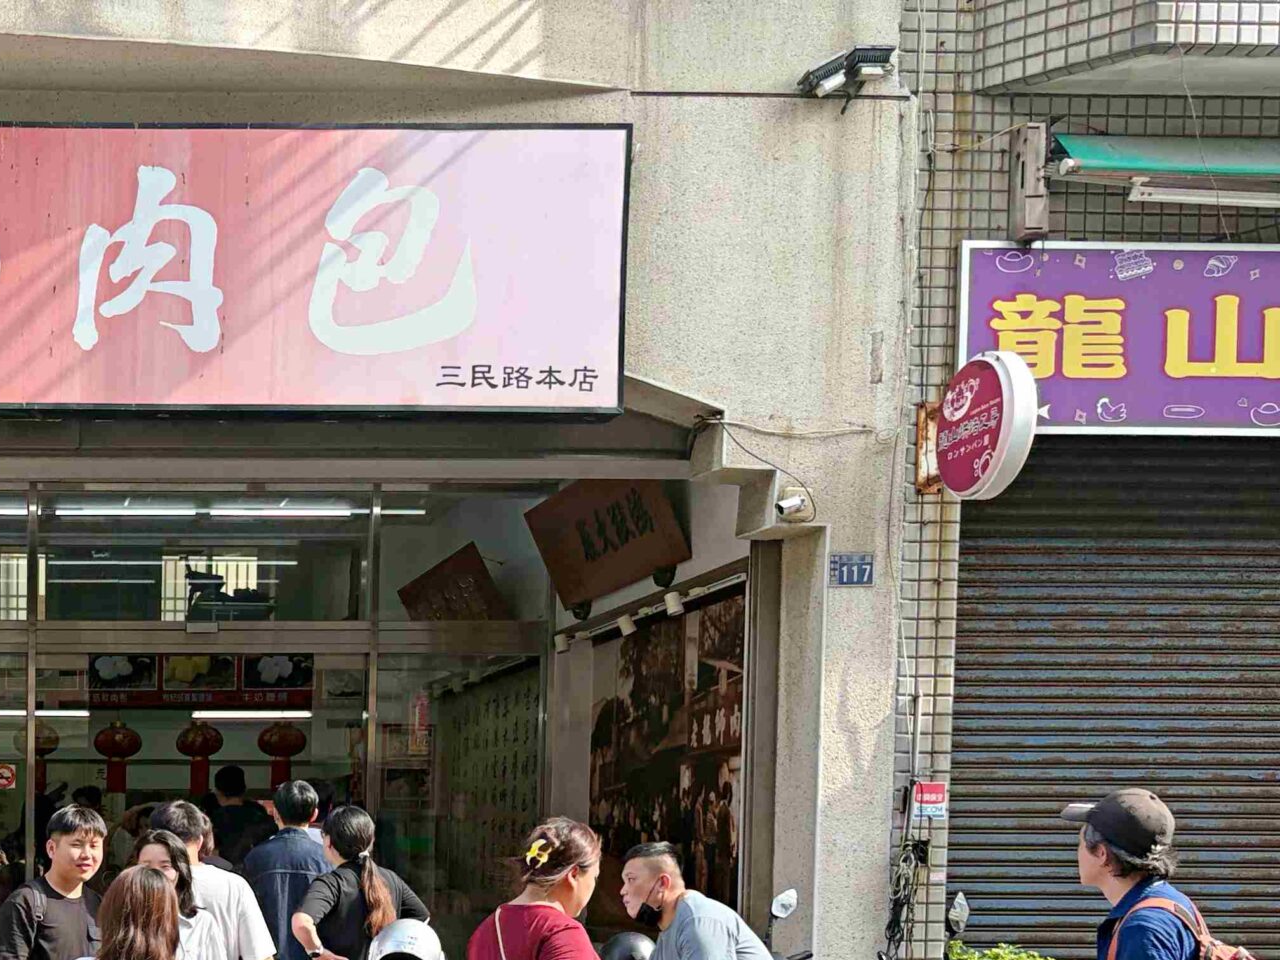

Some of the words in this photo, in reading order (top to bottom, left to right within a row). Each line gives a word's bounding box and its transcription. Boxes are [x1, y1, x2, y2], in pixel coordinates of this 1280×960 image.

[990, 294, 1280, 379] 龍山
[436, 364, 599, 392] 三民路本店
[841, 565, 871, 582] 117
